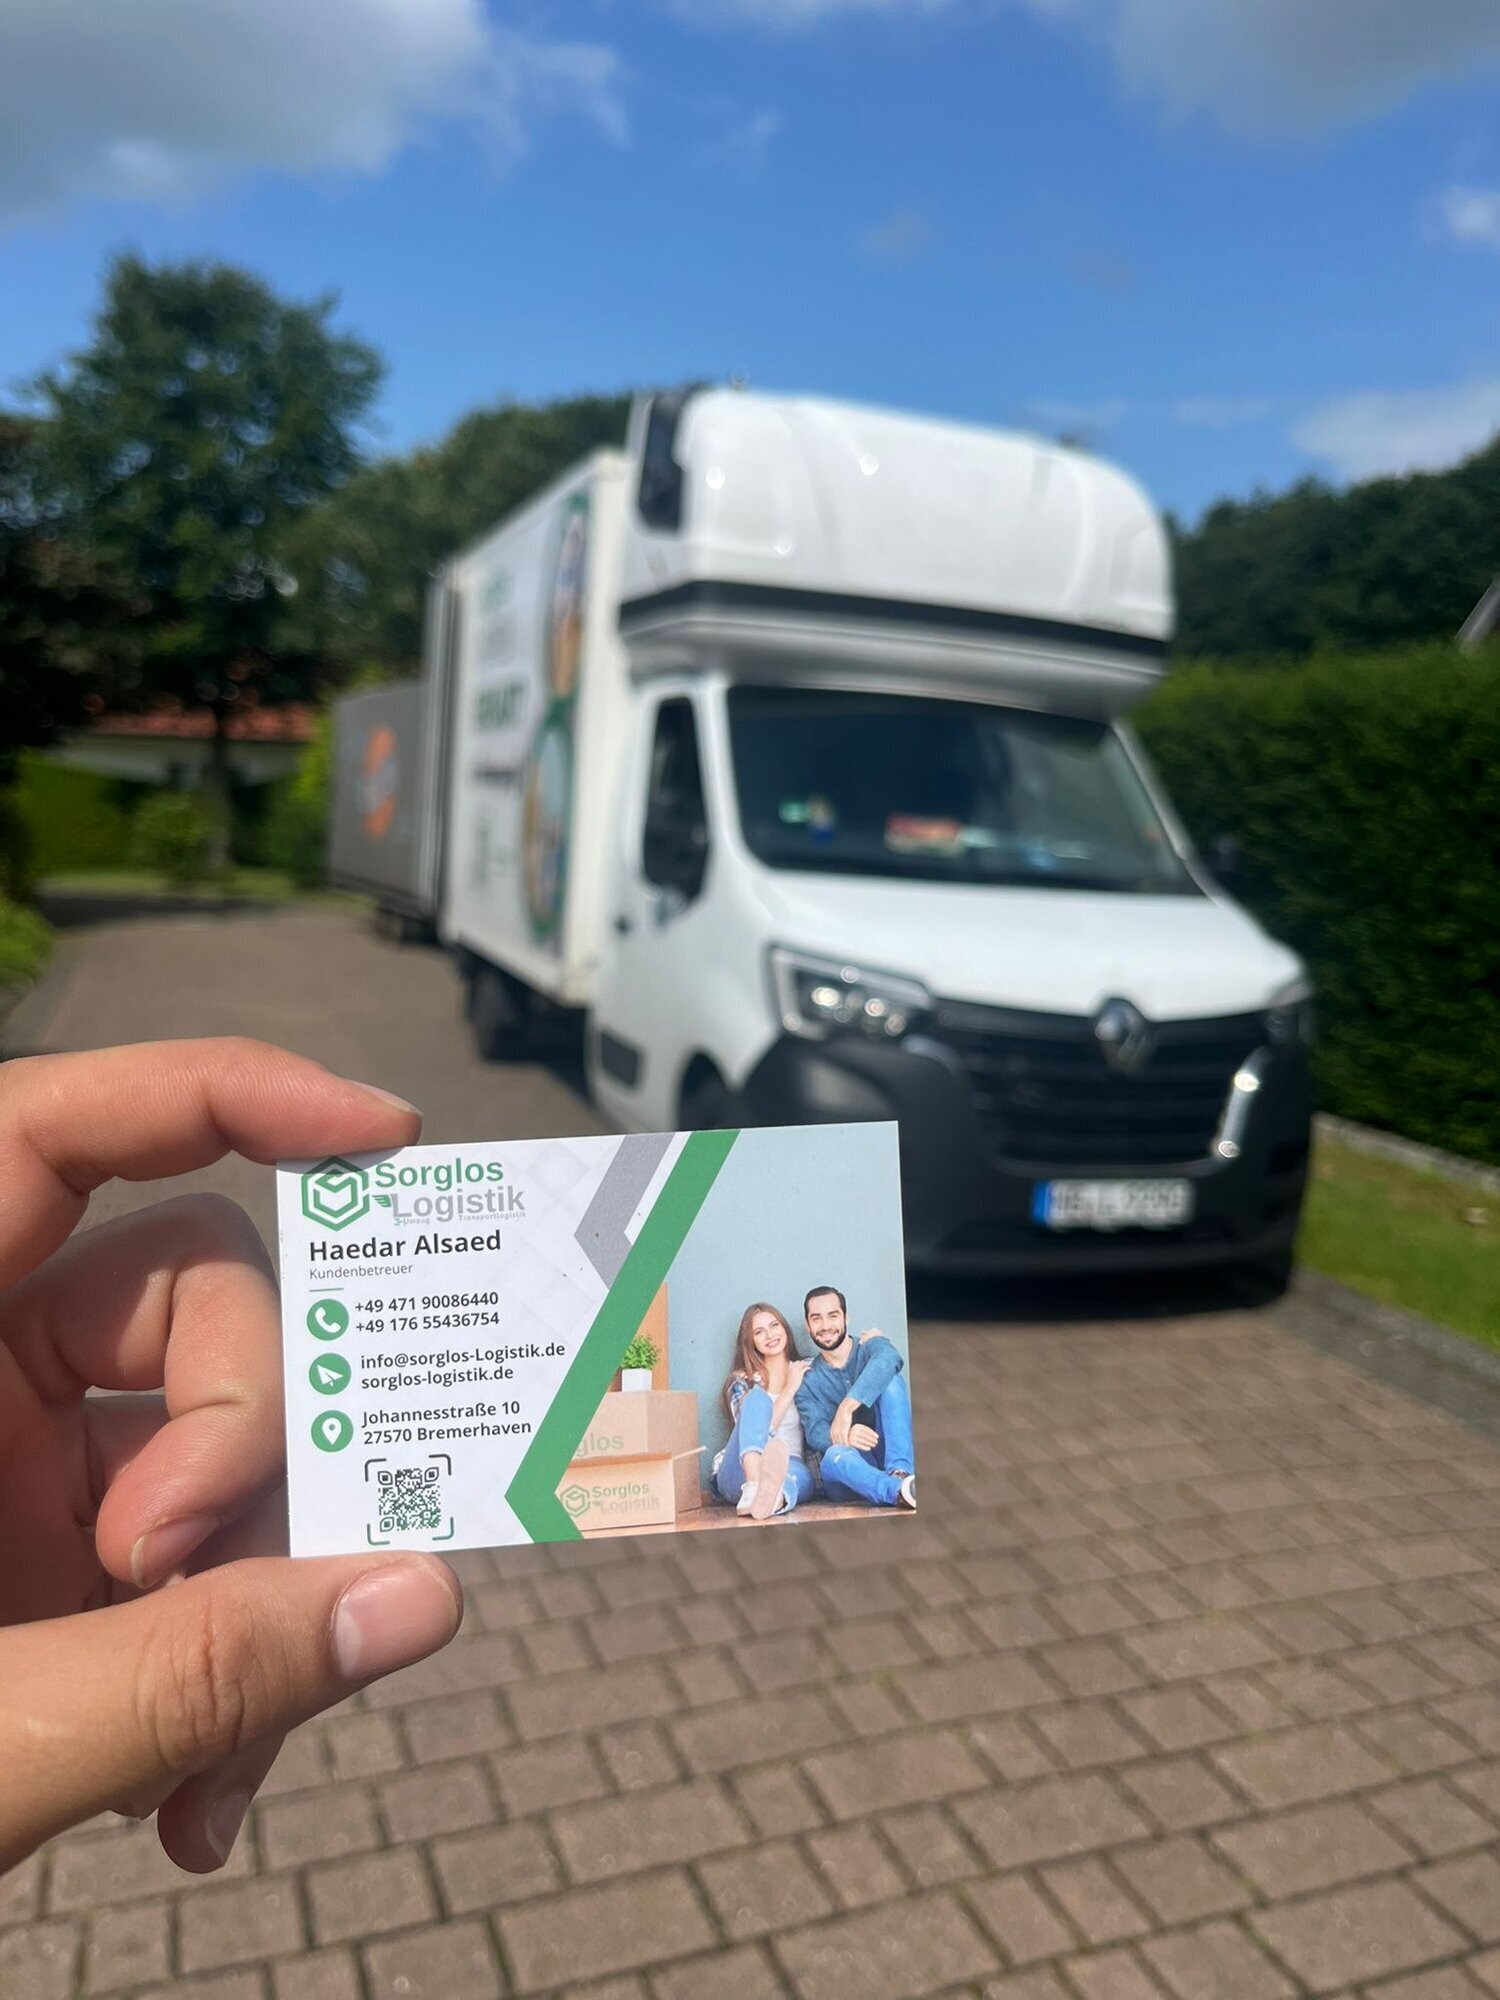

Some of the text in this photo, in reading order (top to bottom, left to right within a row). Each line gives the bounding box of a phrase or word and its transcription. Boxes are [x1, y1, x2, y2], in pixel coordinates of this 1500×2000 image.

[375, 1158, 504, 1192] Sorglos
[392, 1185, 526, 1223] Logistik
[309, 1230, 501, 1261] Haedar Alsaed
[309, 1263, 413, 1280] Kundenbetreuer
[355, 1292, 499, 1312] +49 471 90086440
[356, 1311, 499, 1333] +49 176 55436754
[361, 1343, 566, 1370] info@sorglos-Logistik.de
[361, 1366, 514, 1391] sorglos-logistik.de
[362, 1400, 520, 1428] Johannesstraße 10
[364, 1420, 532, 1445] 27570 Bremerhaven
[593, 1482, 650, 1500] Sorglos
